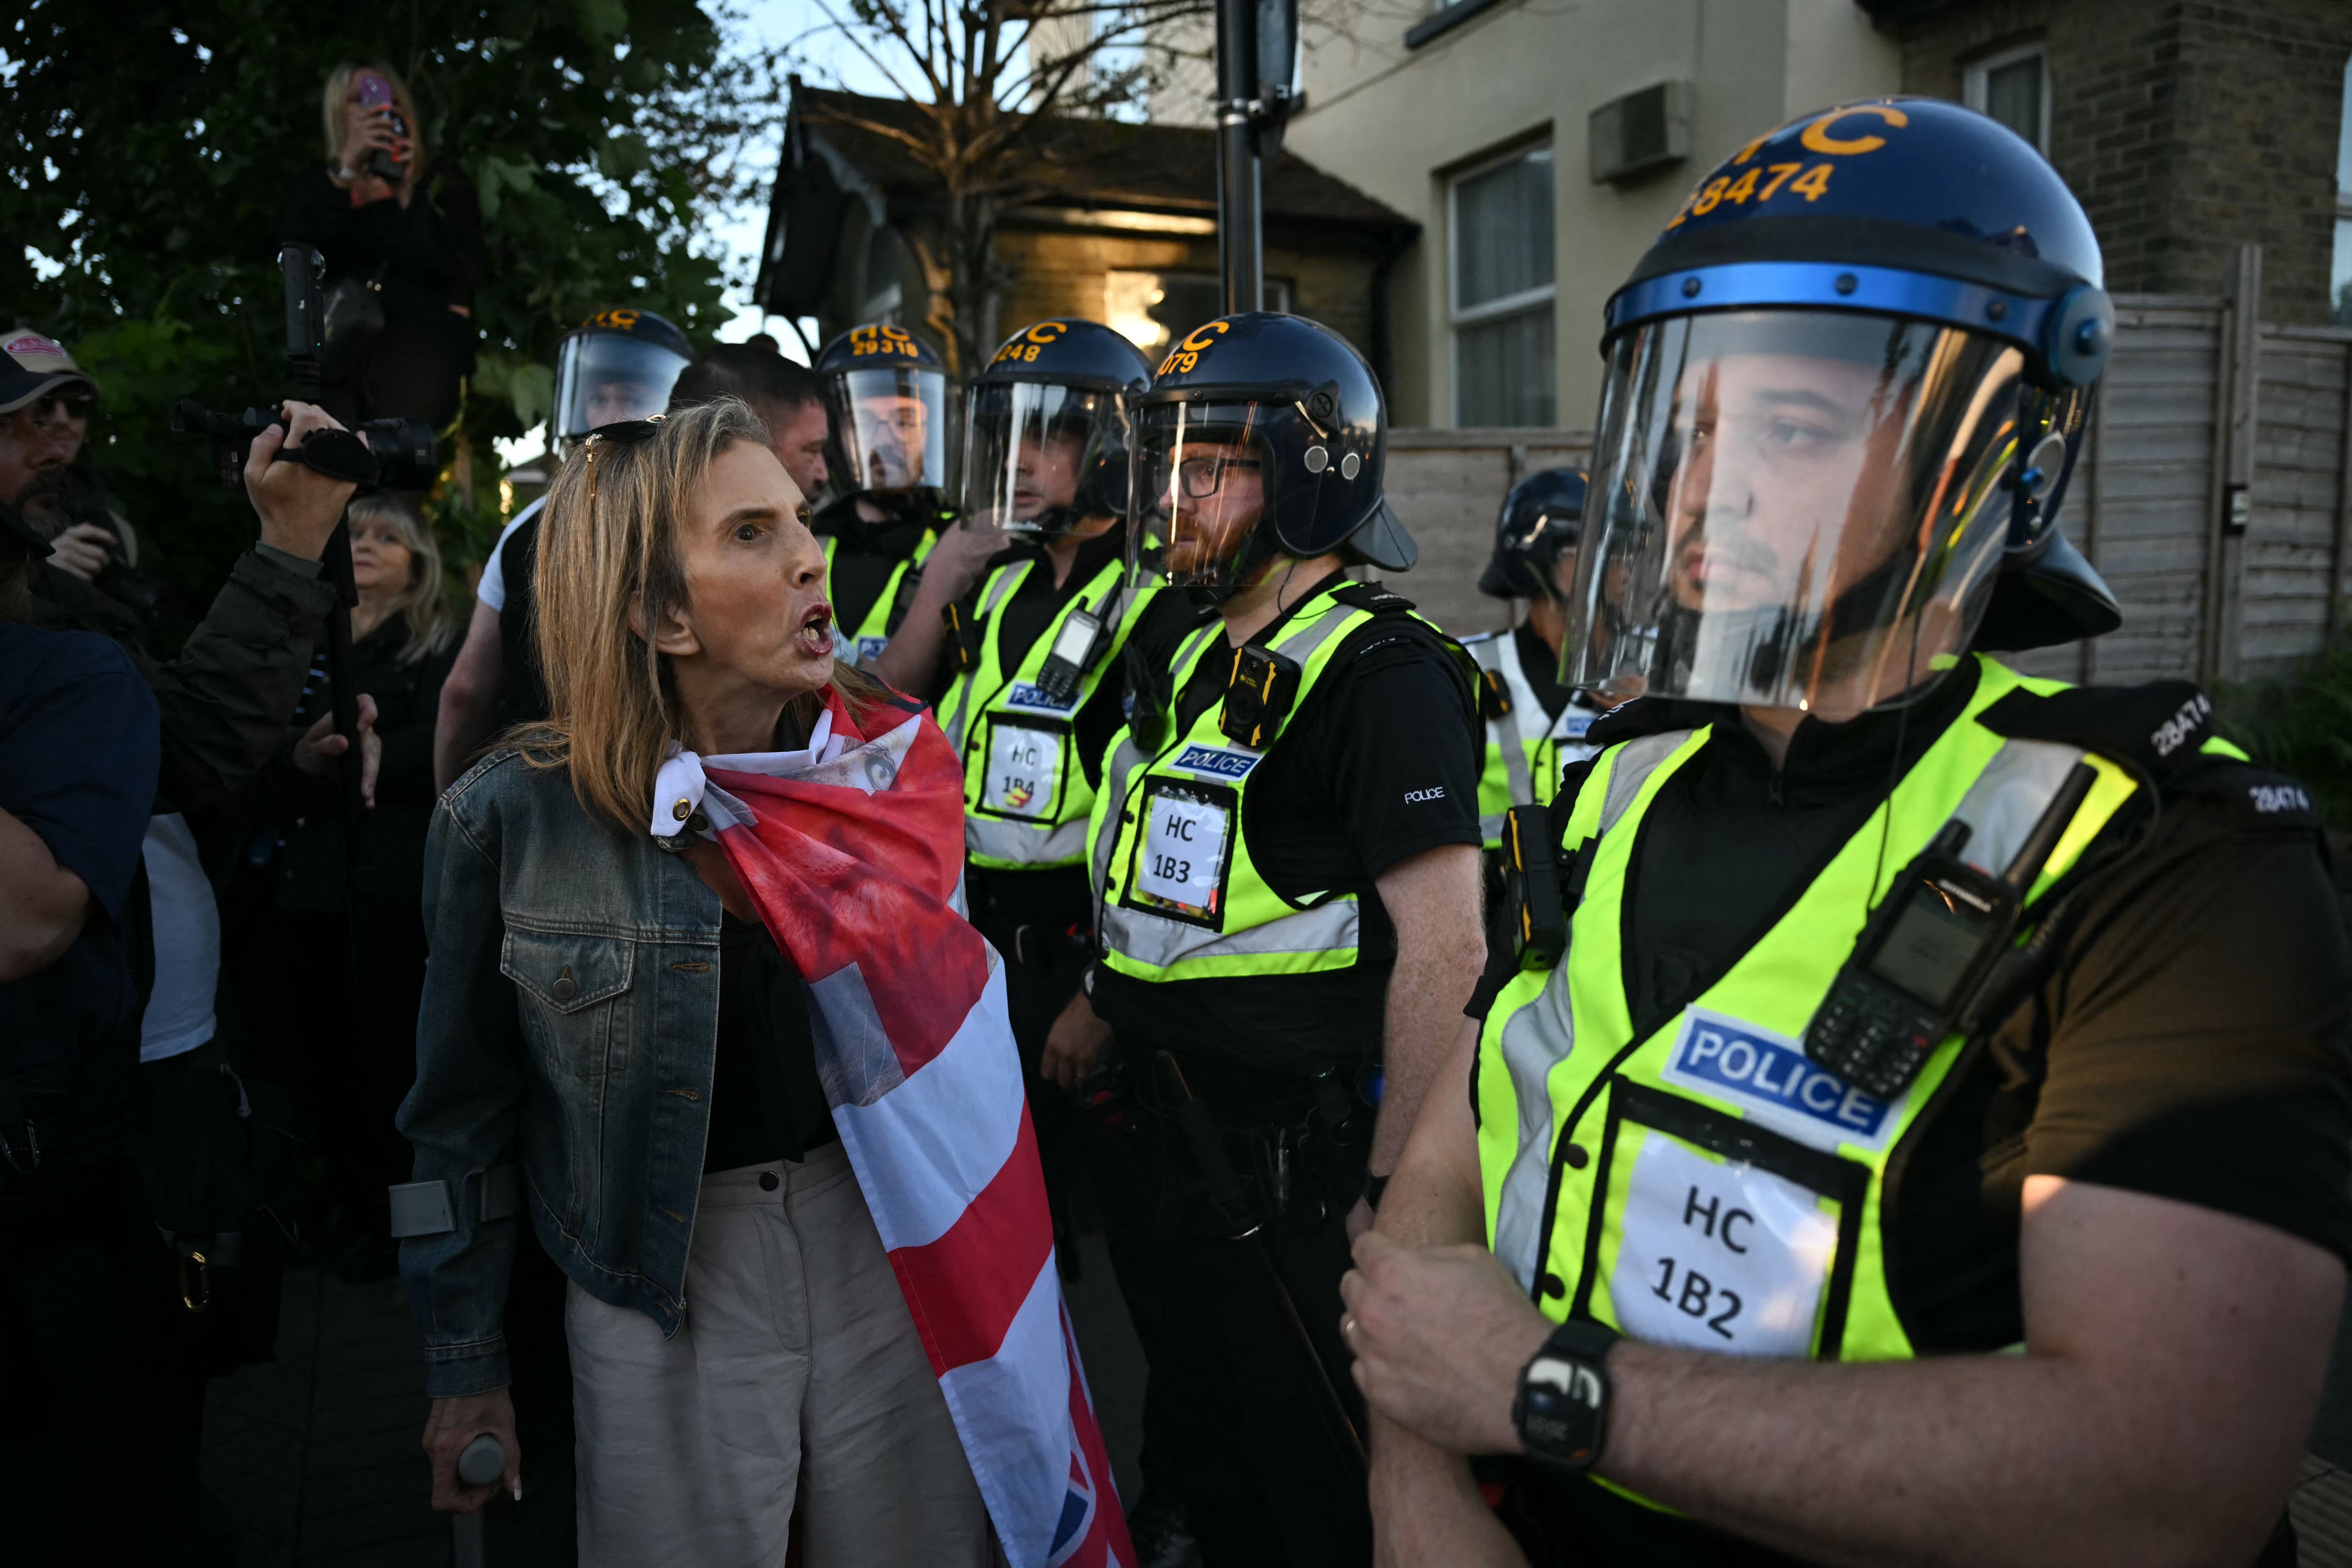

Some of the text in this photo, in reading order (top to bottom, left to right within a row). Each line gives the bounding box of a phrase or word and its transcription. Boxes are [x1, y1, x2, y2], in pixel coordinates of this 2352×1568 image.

[1027, 322, 1067, 344] C
[1182, 321, 1230, 351] C
[1153, 351, 1199, 380] 079
[1014, 686, 1072, 708] POLI
[1012, 745, 1036, 765] HC
[1180, 750, 1251, 773] POLICE
[1404, 786, 1445, 804] POLICE
[1166, 814, 1196, 842] HC
[1153, 854, 1191, 883] 1B3
[1688, 1029, 1874, 1126] POLICE
[1683, 1185, 1755, 1255] HC
[1651, 1257, 1743, 1341] 1B2
